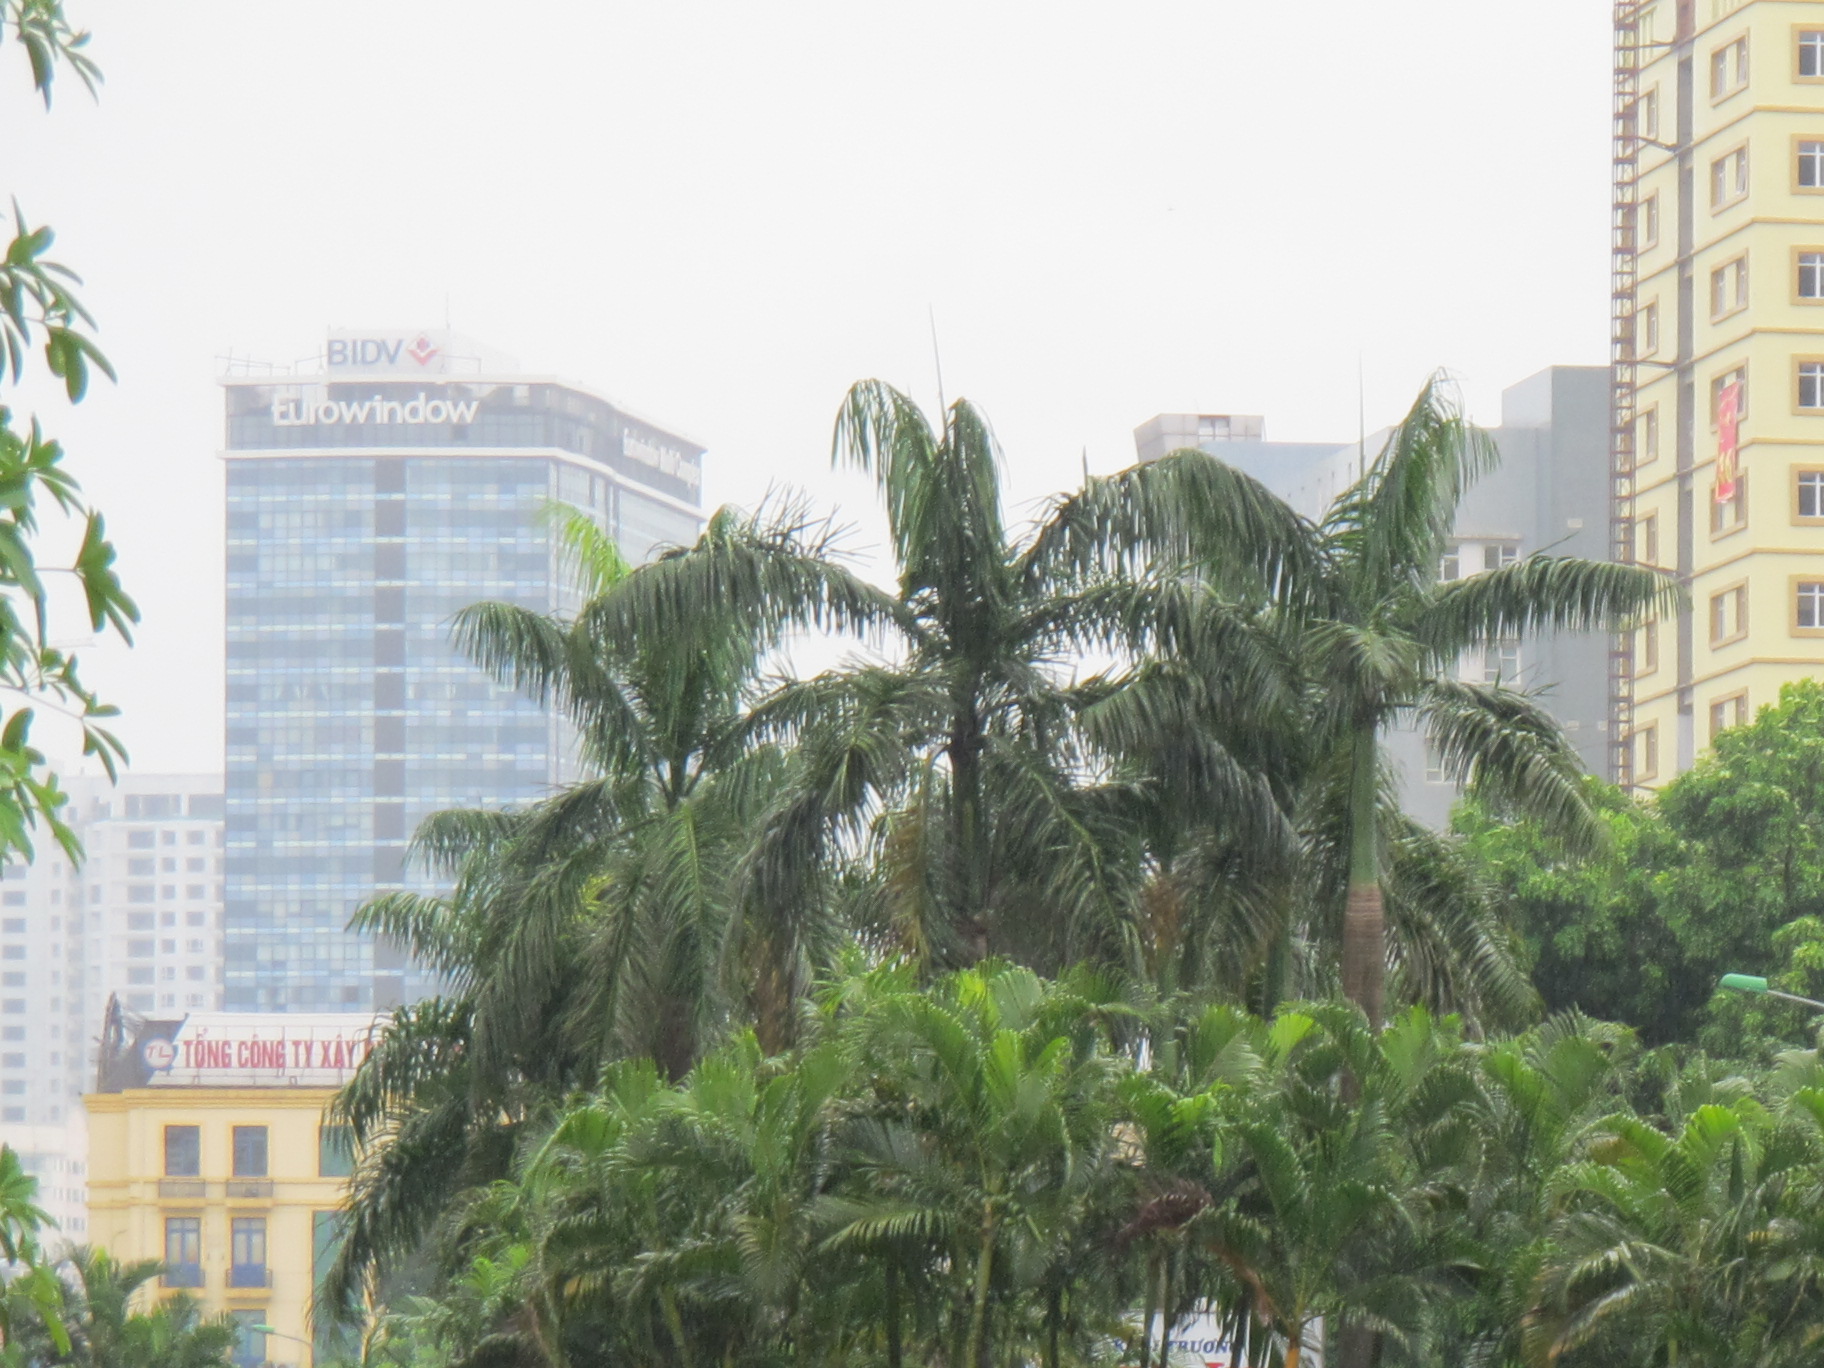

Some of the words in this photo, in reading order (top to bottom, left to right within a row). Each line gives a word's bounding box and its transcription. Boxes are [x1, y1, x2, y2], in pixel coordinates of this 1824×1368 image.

[327, 338, 404, 366] BIDV
[272, 393, 480, 427] Eurowindow
[183, 1028, 232, 1069] TỔNG
[237, 1034, 286, 1069] CÔNG
[292, 1040, 314, 1069] TY
[321, 1034, 357, 1069] XÂY
